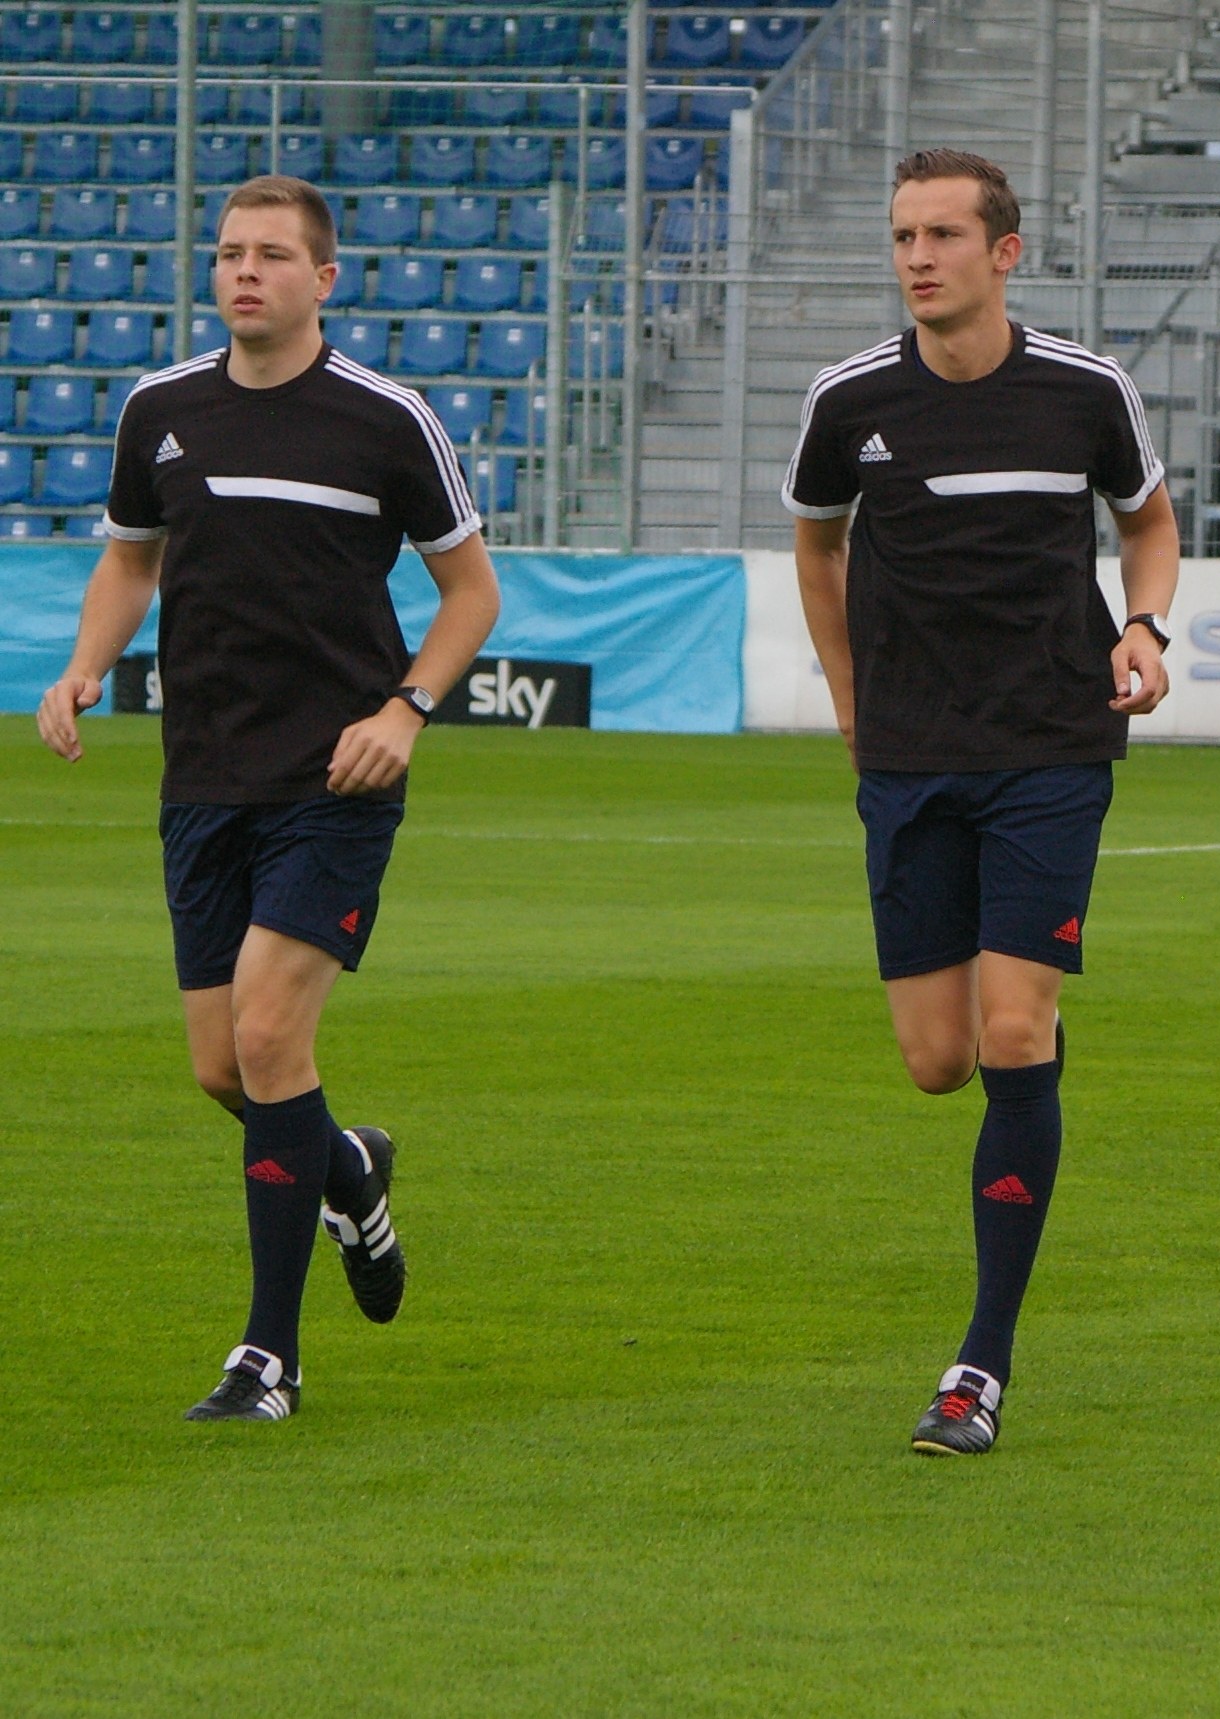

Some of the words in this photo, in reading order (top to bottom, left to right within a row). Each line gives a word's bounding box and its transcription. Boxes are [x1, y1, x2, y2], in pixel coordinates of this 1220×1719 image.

[156, 448, 184, 464] adidas
[859, 451, 892, 463] adidas
[469, 659, 555, 728] sky
[982, 1185, 1033, 1206] adidas
